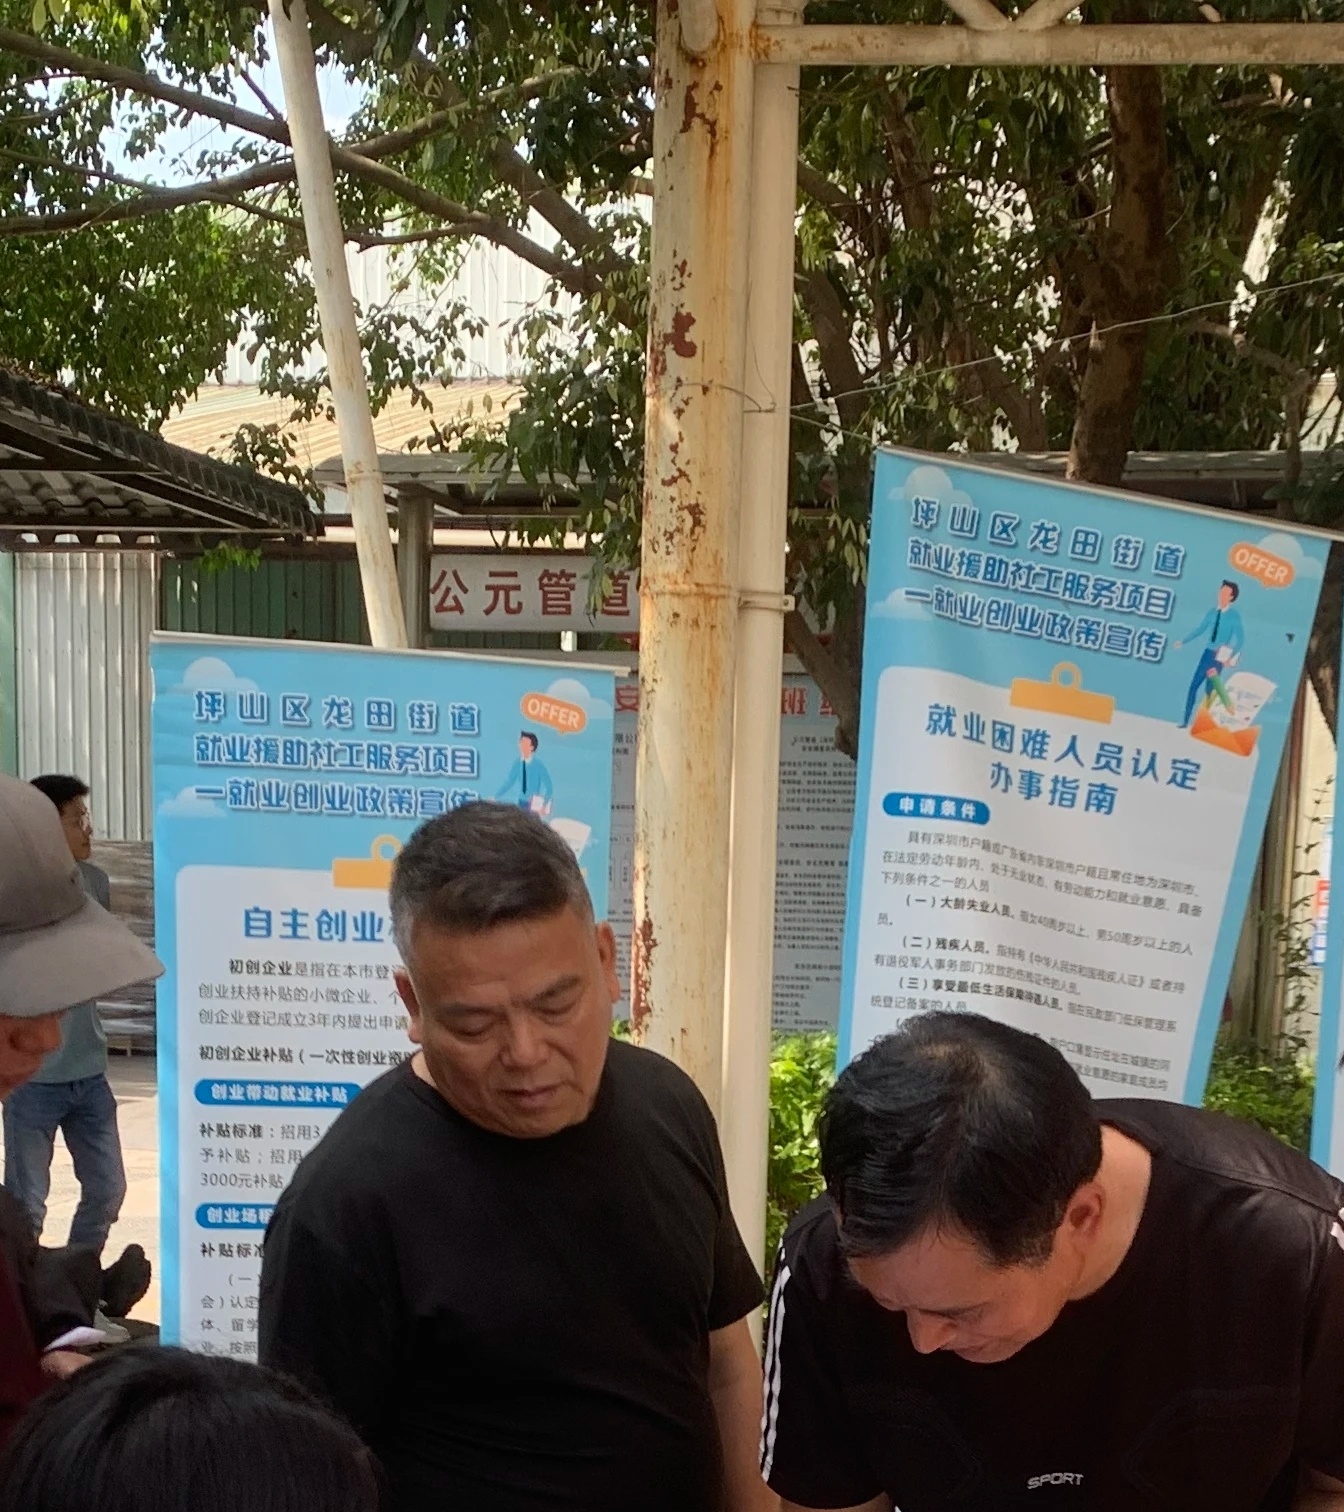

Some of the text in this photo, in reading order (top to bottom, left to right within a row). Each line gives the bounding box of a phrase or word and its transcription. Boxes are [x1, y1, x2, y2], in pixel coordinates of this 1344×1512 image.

[911, 496, 1185, 577] 坪山区龙田街道
[908, 537, 1174, 619] 就业援助社工服务项目
[1235, 548, 1289, 584] OFFER
[430, 569, 639, 616] 公元管道
[194, 690, 481, 735] 坪山区龙田街道
[527, 698, 581, 729] OFFER
[194, 733, 480, 778] 就业援助社工服务项目
[925, 703, 1202, 792] 就业困难人员认定
[899, 794, 977, 822] 申请条件
[989, 761, 1119, 817] 办事指南
[244, 906, 396, 943] 自主创业
[229, 958, 405, 980] 初创企业是指在本市登
[1027, 1472, 1084, 1490] SPORT
